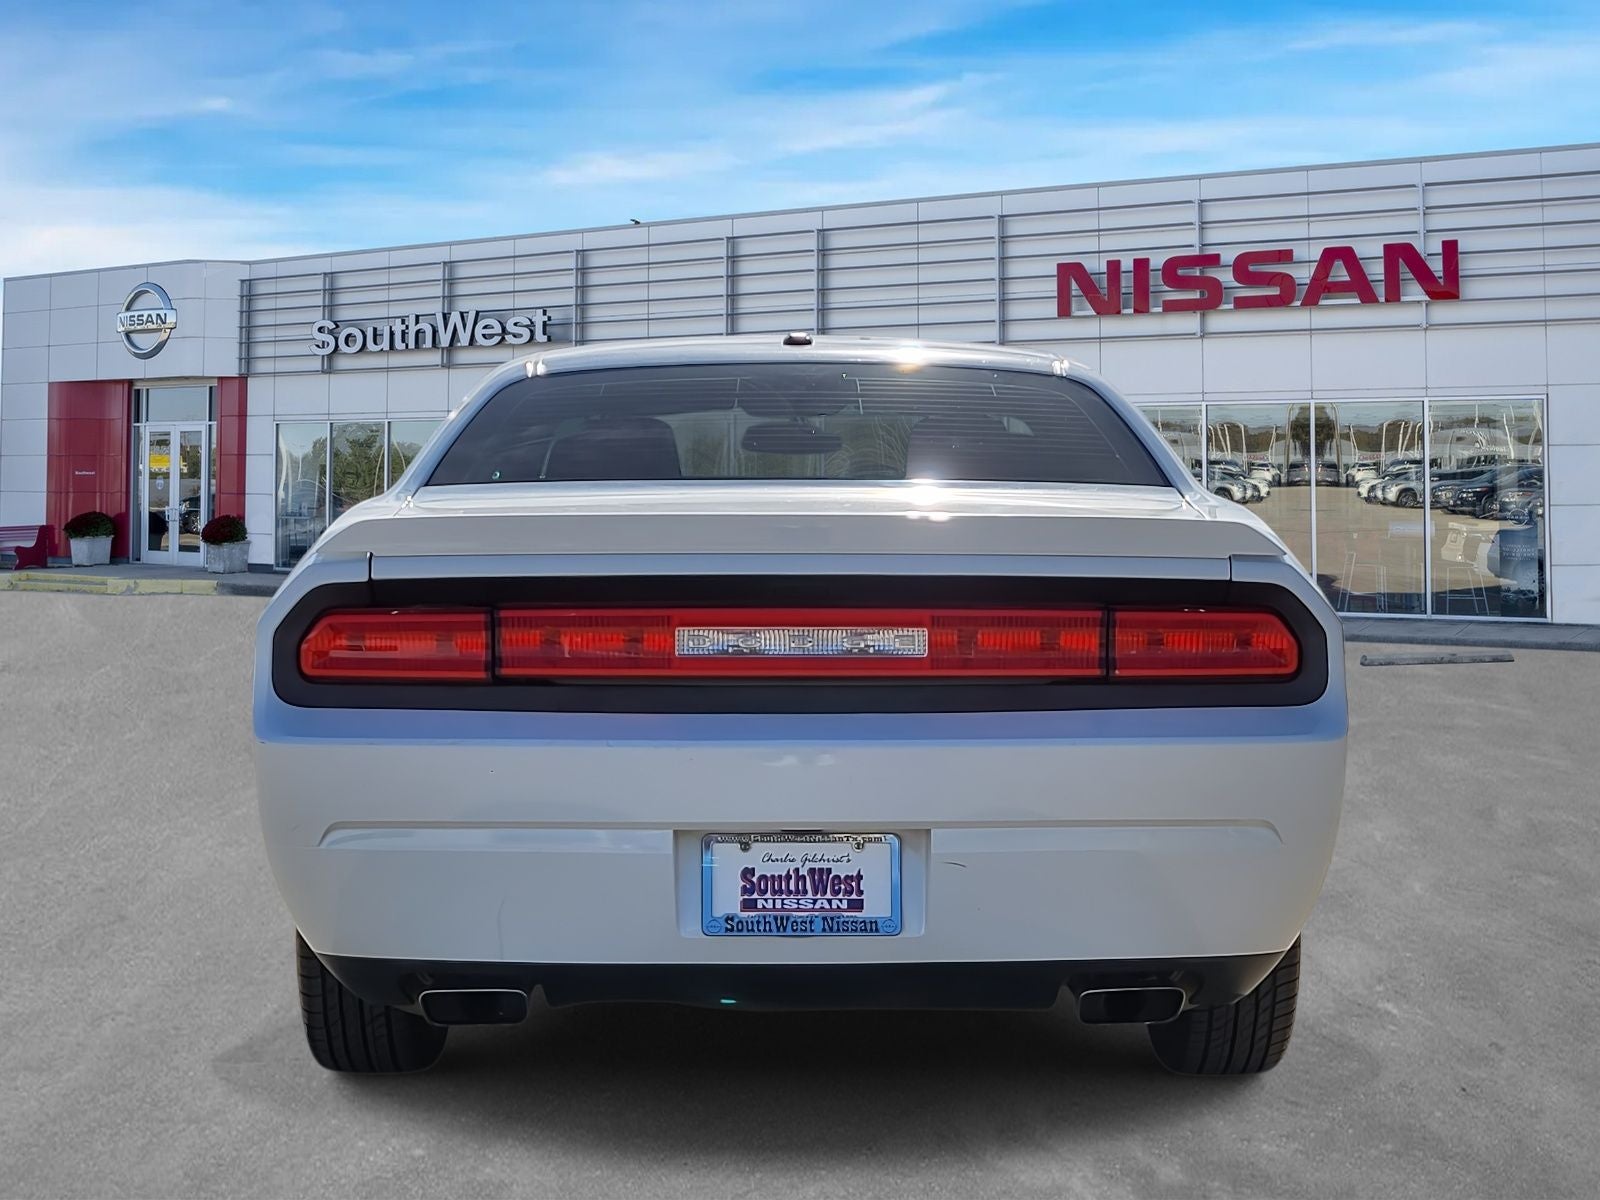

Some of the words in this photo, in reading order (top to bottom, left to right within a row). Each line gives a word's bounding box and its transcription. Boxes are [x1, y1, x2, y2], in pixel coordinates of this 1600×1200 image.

[1056, 239, 1461, 318] NISSAN
[119, 312, 167, 328] NISSAN
[309, 308, 551, 356] SouthWest
[761, 852, 797, 864] Charlie
[740, 866, 864, 897] SouthWest
[756, 898, 848, 909] NISSAN
[724, 914, 816, 933] SouthWest
[821, 915, 880, 933] Nissan
